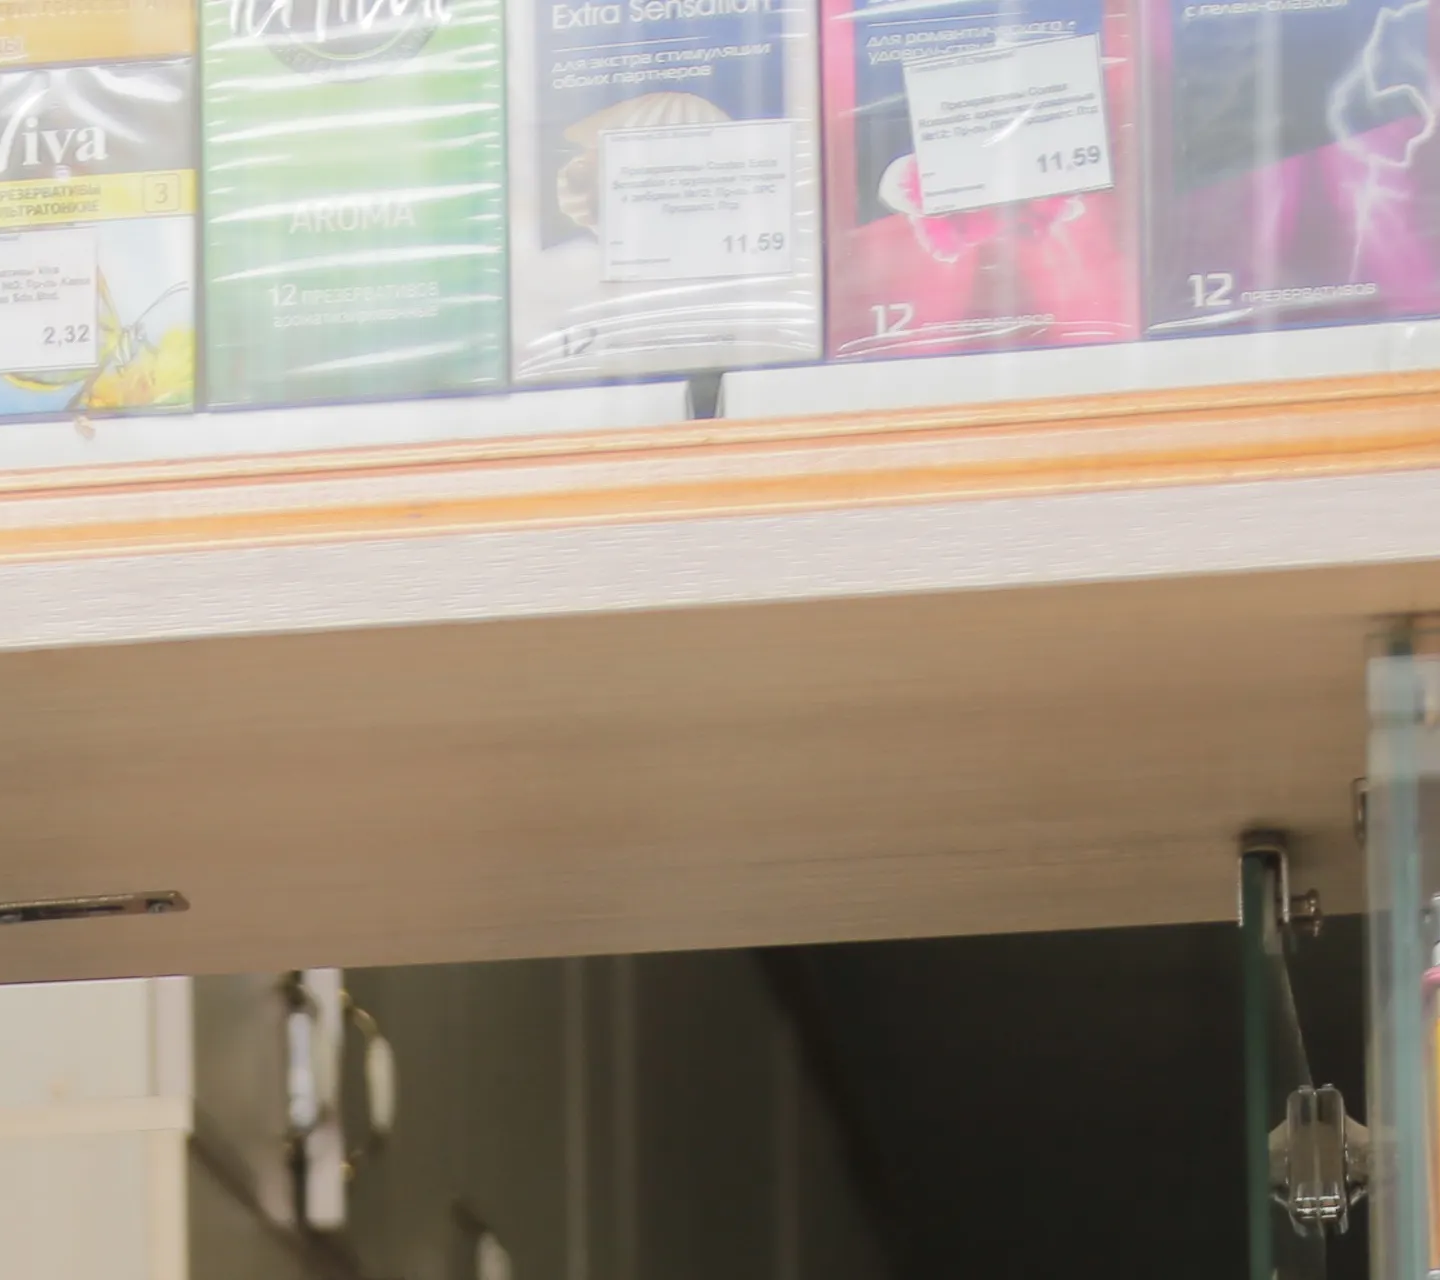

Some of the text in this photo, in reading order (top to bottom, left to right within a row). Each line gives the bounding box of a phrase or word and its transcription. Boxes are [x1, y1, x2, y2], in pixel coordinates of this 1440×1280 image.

[551, 3, 621, 30] Extra
[551, 59, 586, 74] для
[587, 53, 654, 72] экстра
[552, 65, 712, 90] обоих партнеров
[1035, 145, 1102, 174] 11,59
[289, 200, 417, 235] AROMA
[269, 283, 299, 307] 12
[1187, 272, 1234, 308] 12
[869, 302, 915, 337] 12
[42, 323, 91, 347] 2,32
